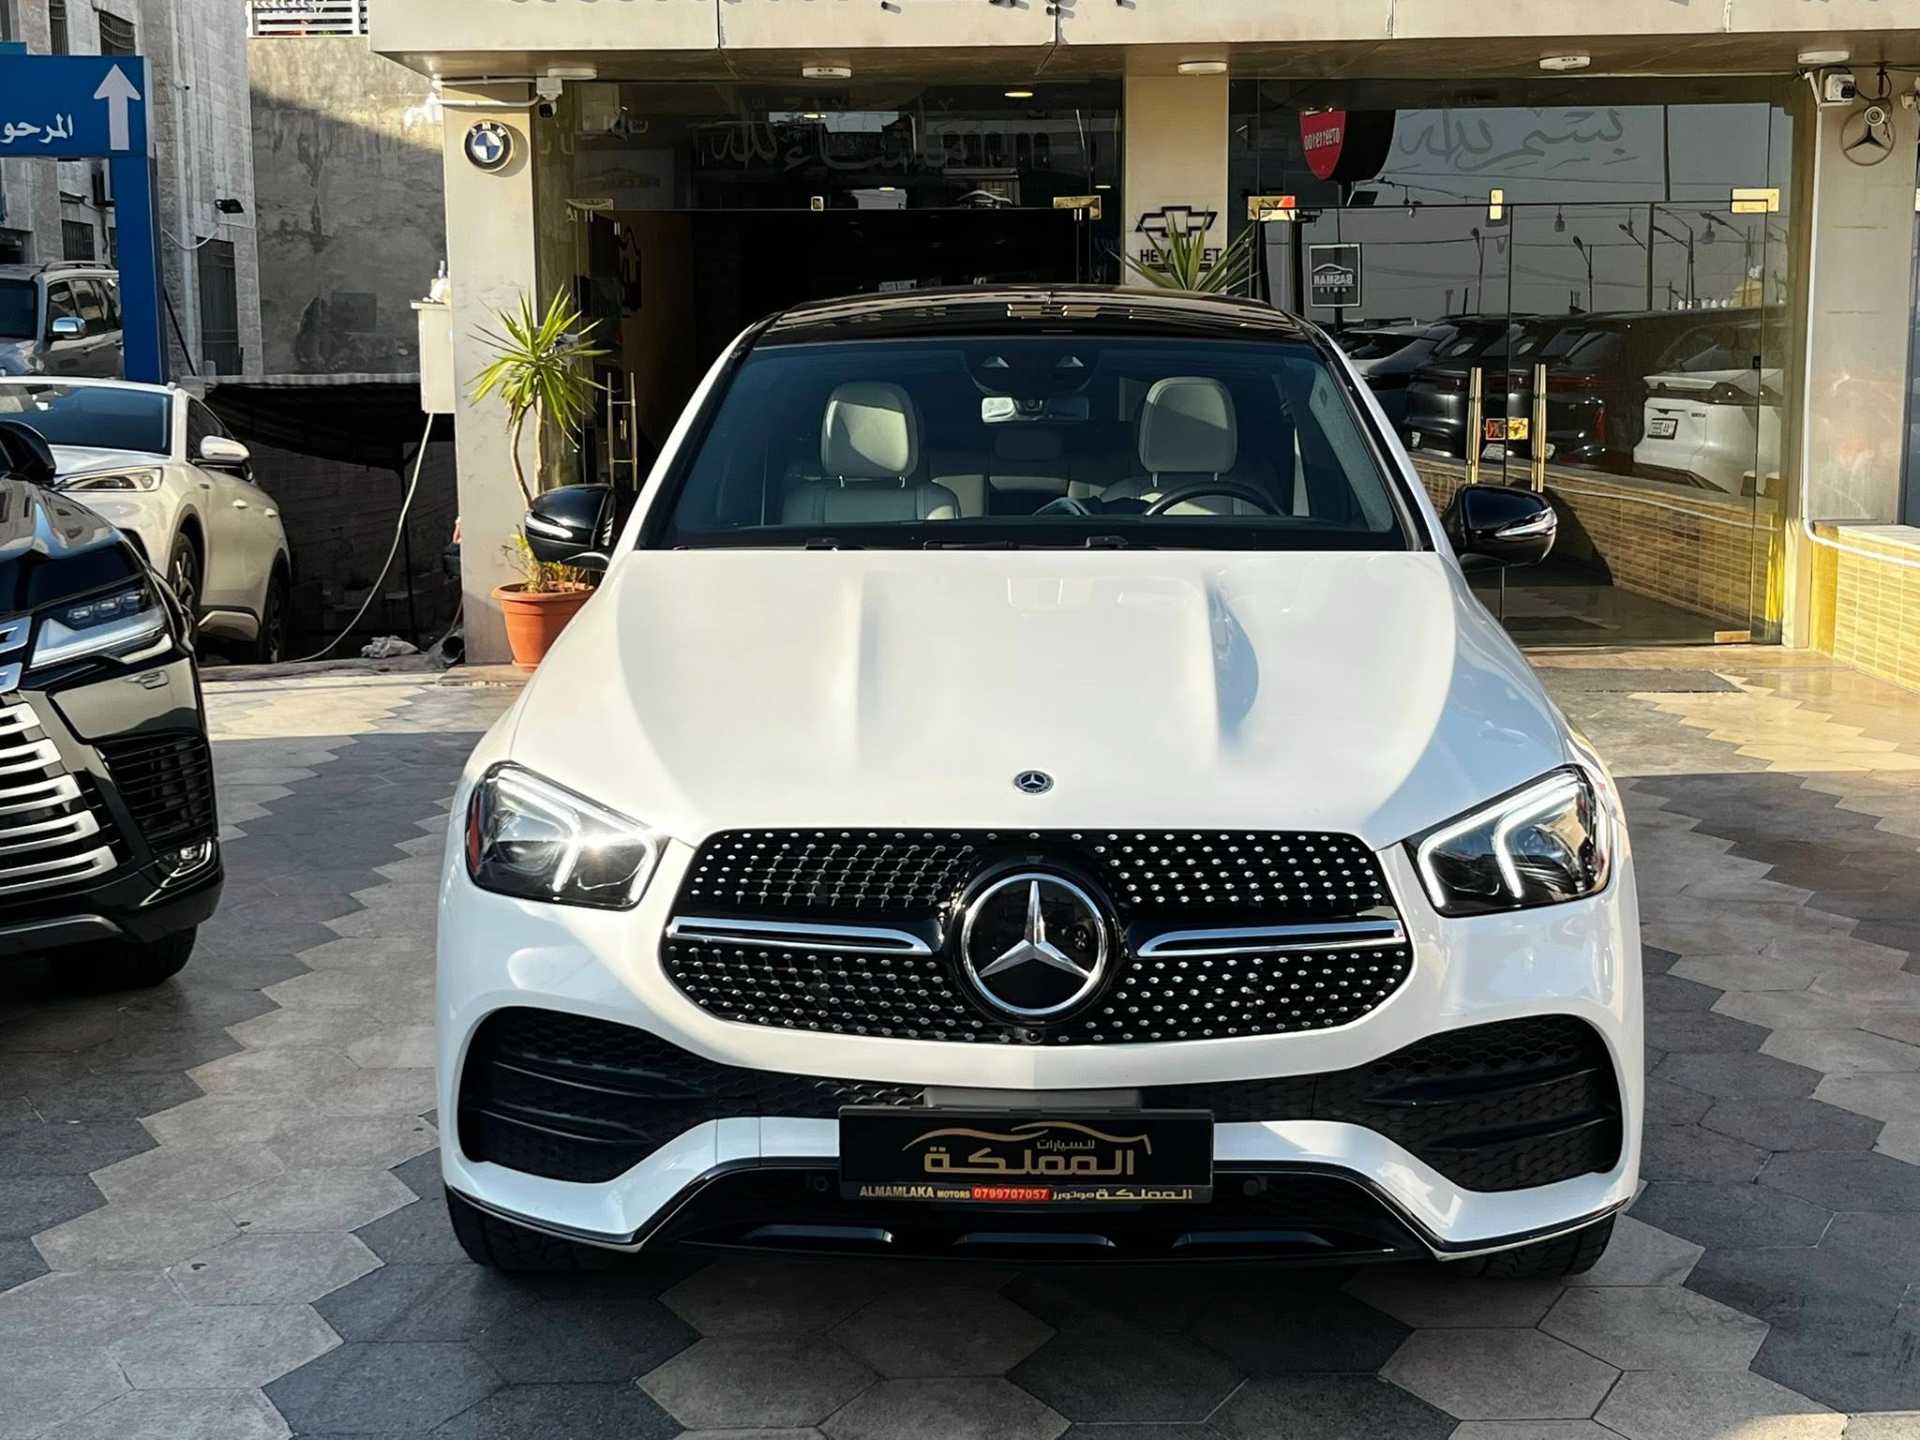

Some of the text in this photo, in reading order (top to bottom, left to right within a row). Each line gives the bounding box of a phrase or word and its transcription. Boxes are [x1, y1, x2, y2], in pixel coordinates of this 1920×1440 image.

[924, 1147, 1135, 1175] المملكة
[859, 1185, 1047, 1200] ALMAMLAKA MOTORS 0799707057
[1096, 1188, 1192, 1200] المملكة
